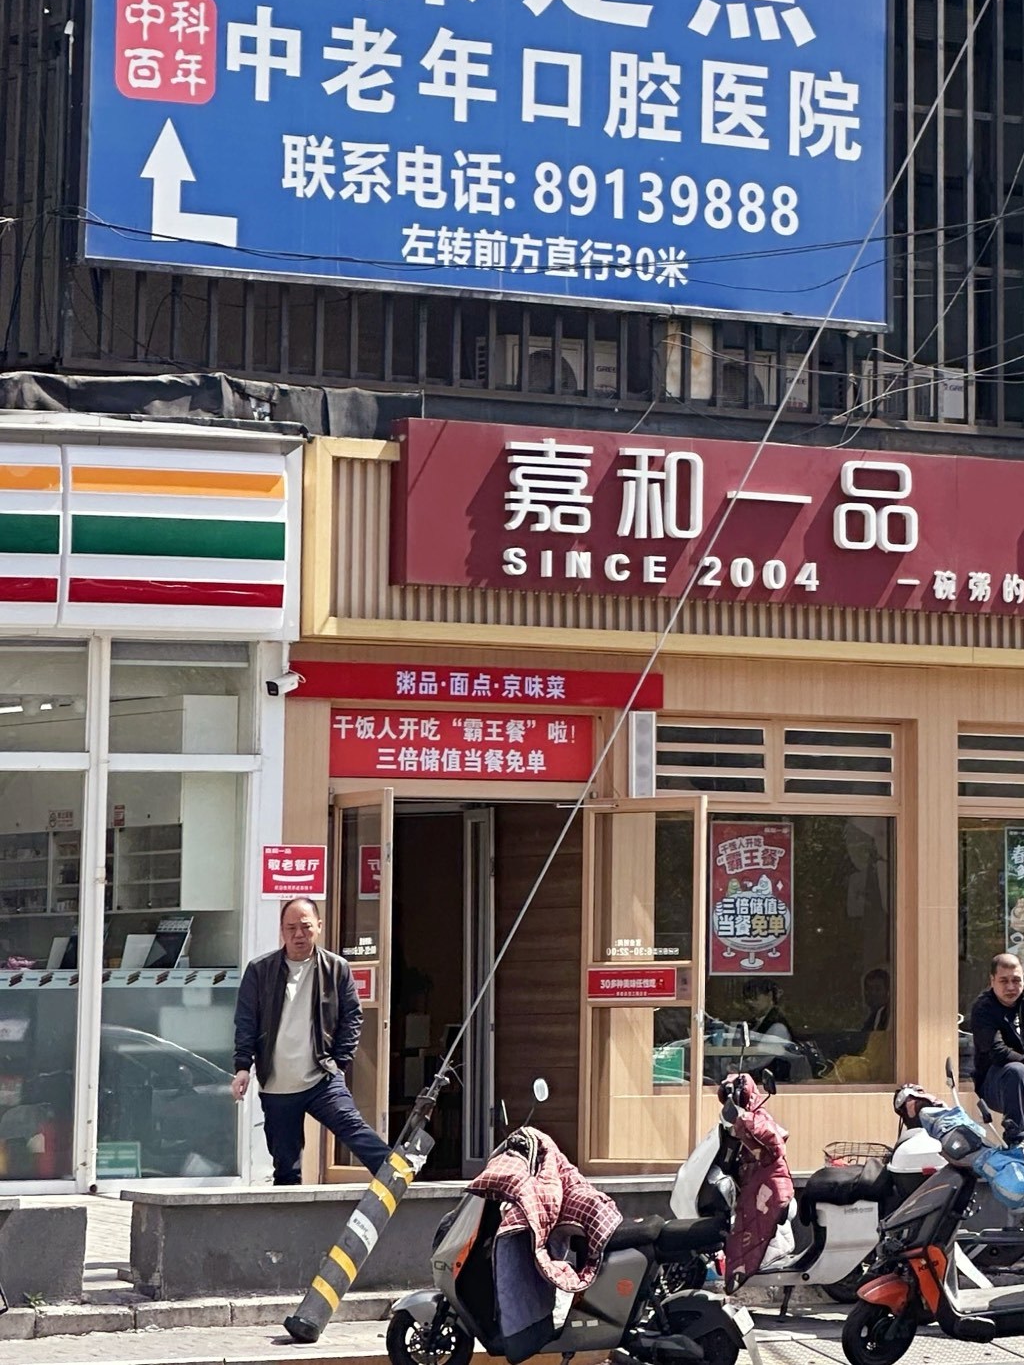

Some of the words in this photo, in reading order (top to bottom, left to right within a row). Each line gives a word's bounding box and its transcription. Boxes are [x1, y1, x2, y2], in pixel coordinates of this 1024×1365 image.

[124, 48, 208, 97] 百年
[226, 6, 863, 163] 中老年口腔医院
[400, 224, 690, 290] 左转前方直行30米
[505, 438, 918, 554] 嘉和一品
[503, 547, 667, 583] SINCE
[699, 556, 819, 593] 2004
[376, 747, 547, 774] 三倍储值当餐免单
[268, 859, 320, 871] 敬老餐厅
[718, 915, 785, 937] 当餐免单
[722, 897, 778, 915] 三倍储值
